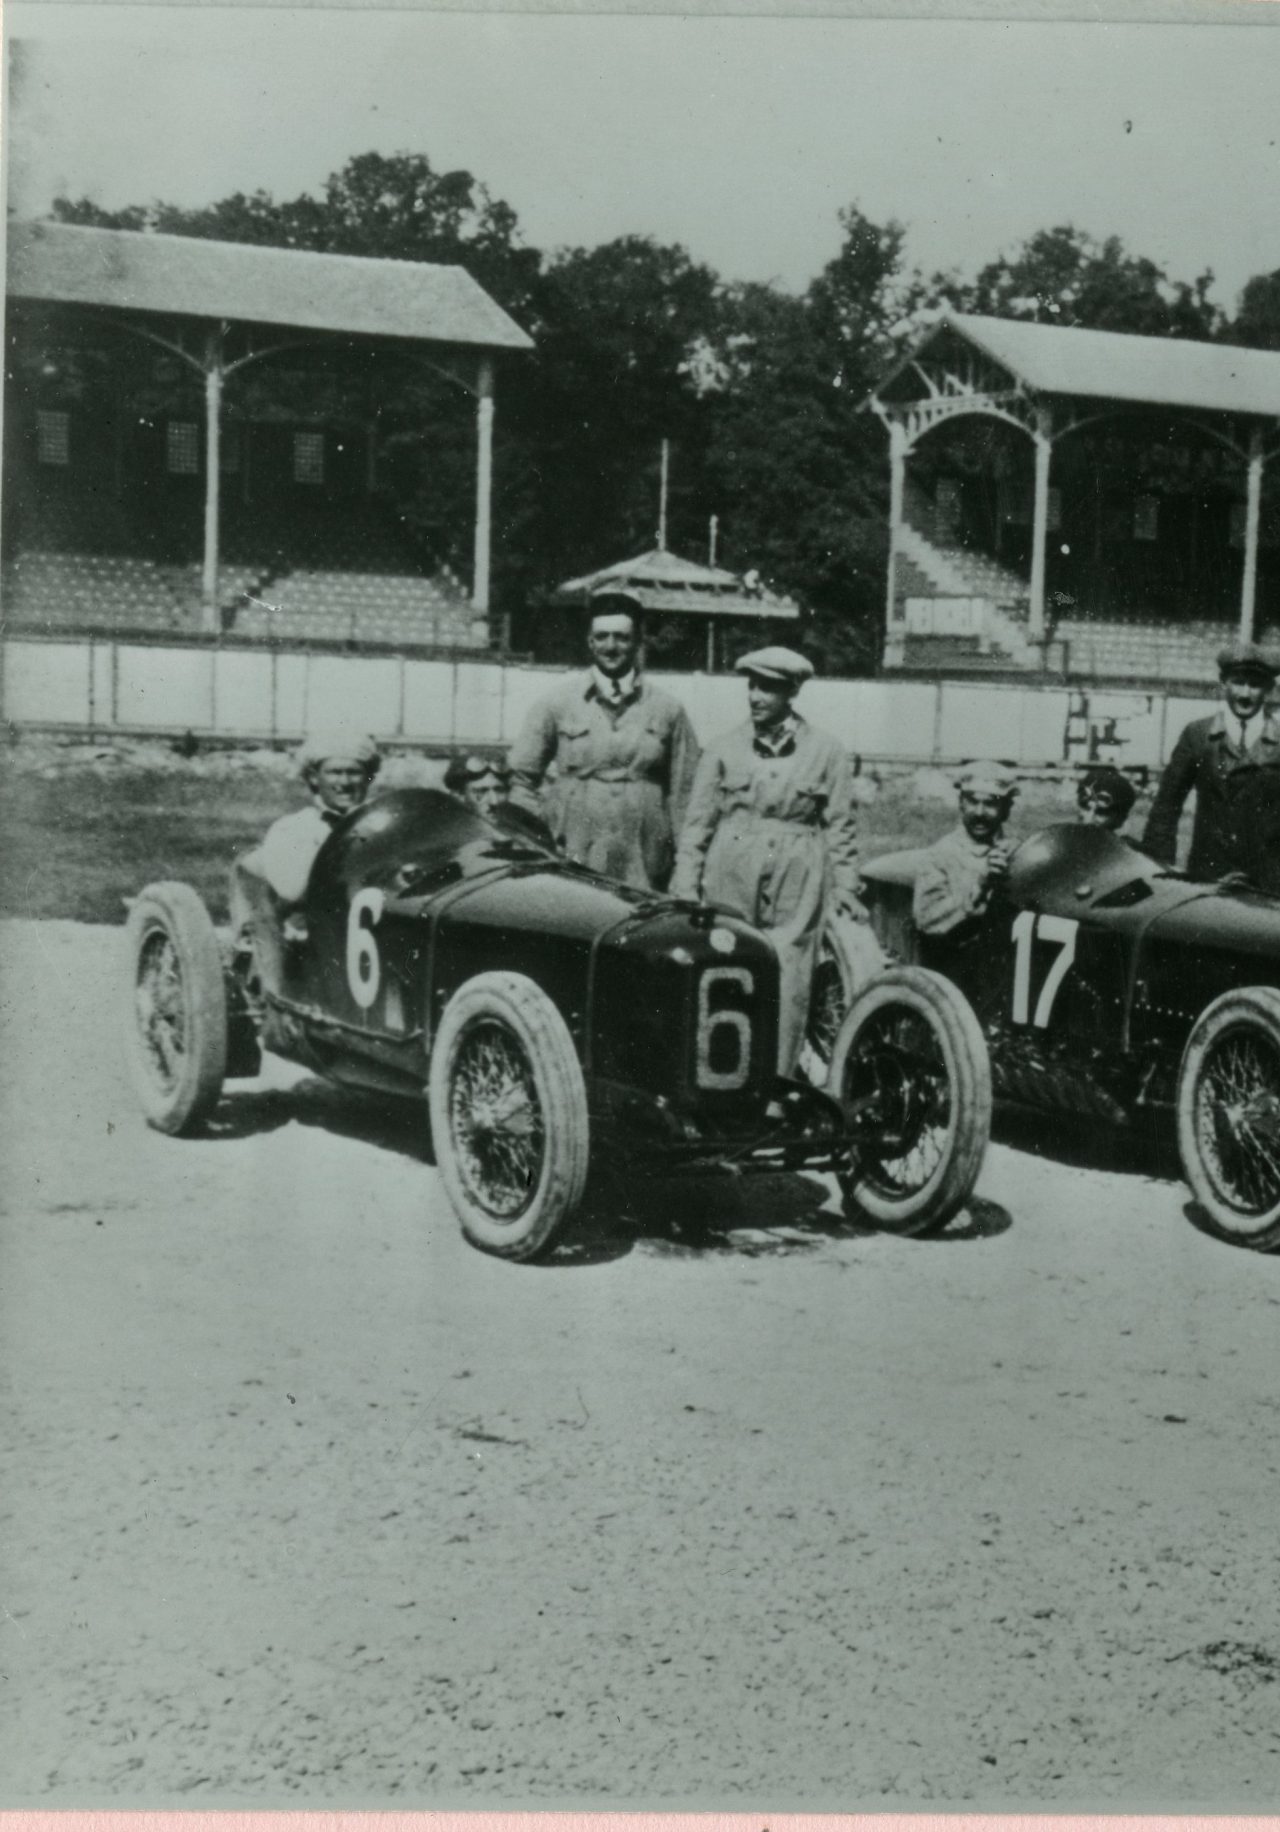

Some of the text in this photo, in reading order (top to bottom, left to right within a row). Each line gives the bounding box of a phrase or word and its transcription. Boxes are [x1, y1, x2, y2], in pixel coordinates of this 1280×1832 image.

[346, 887, 384, 1008] 6
[1012, 910, 1079, 1028] 17
[696, 967, 754, 1090] 6
